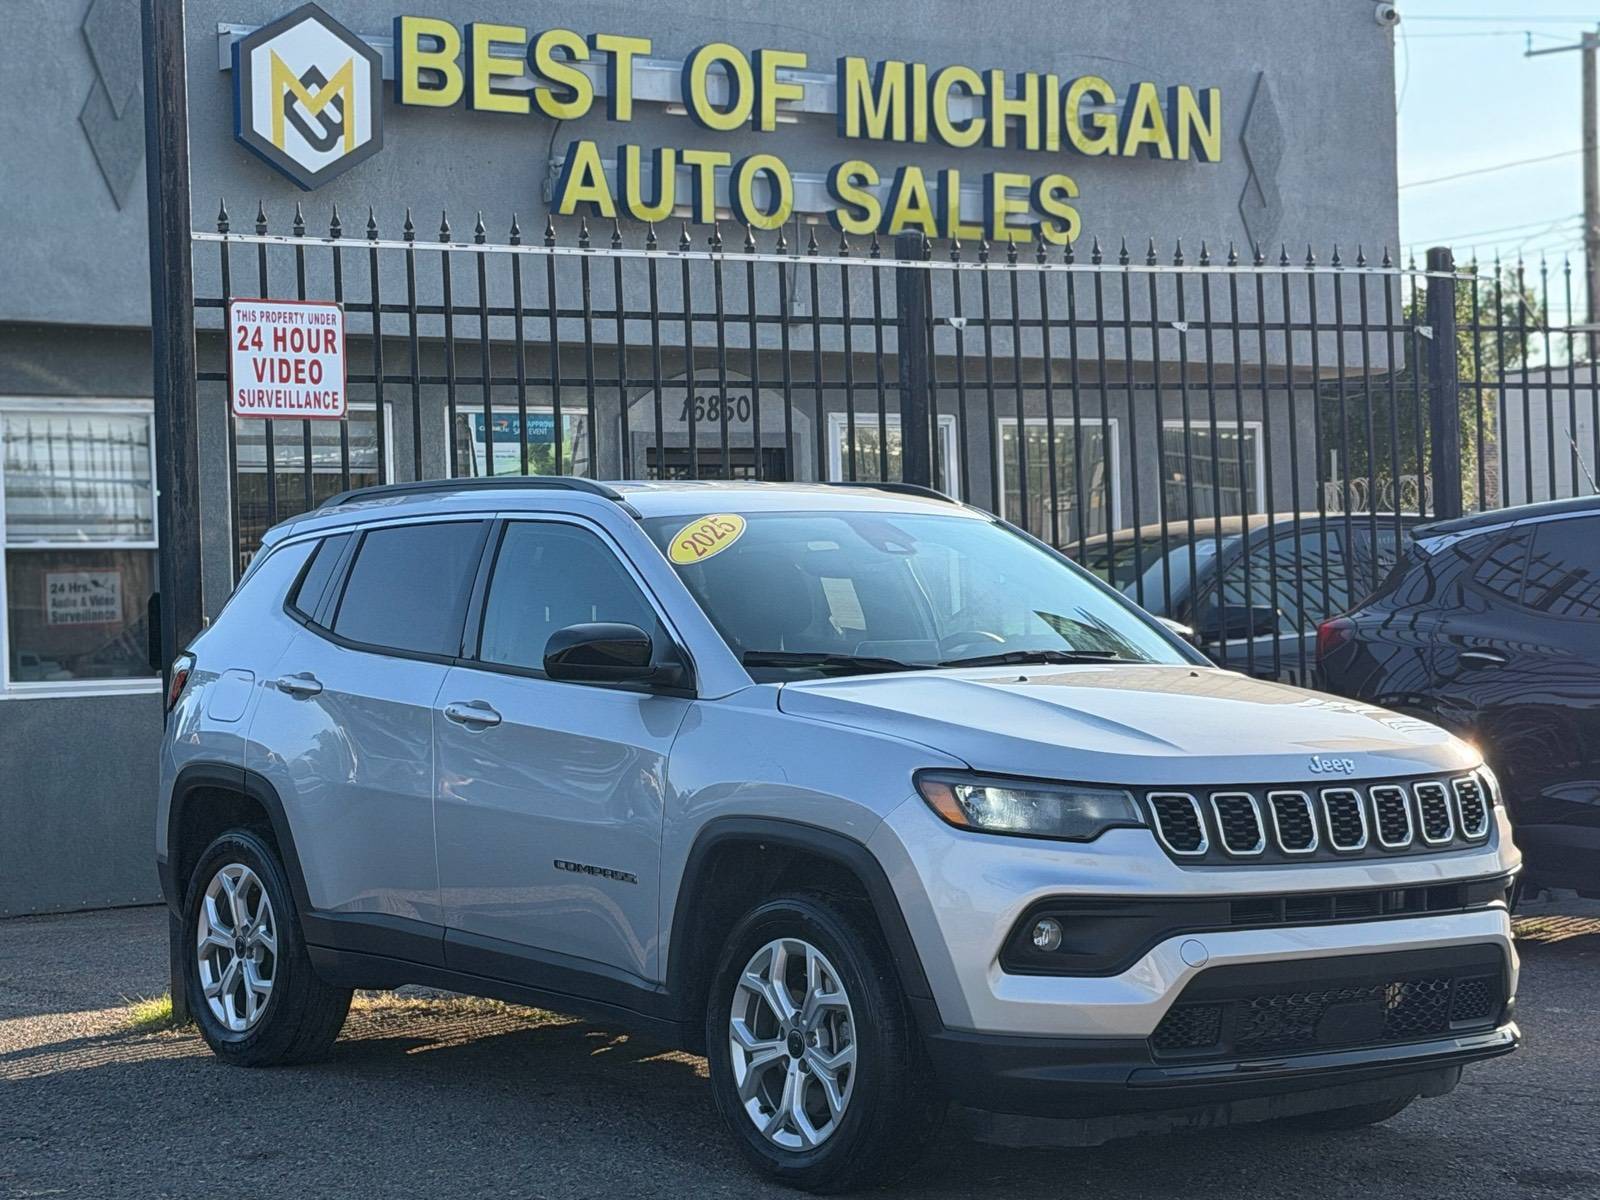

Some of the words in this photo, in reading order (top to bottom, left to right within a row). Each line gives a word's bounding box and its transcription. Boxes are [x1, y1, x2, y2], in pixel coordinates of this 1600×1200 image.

[397, 15, 651, 121] BEST
[687, 43, 808, 131] OF
[841, 56, 1221, 163] MICHIGAN
[556, 140, 795, 230] AUTO
[831, 160, 1082, 245] SALES
[236, 310, 257, 323] THIS
[260, 311, 305, 324] PROPERTY
[308, 313, 337, 325] UNDER
[237, 325, 264, 351] 24
[273, 327, 338, 354] HOUR
[252, 358, 323, 385] VIDEO
[239, 389, 339, 409] SURVEILLANCE
[681, 517, 736, 557] 2025
[50, 583, 65, 594] 24
[1308, 755, 1356, 775] Jeep
[553, 859, 638, 885] COMPASS
